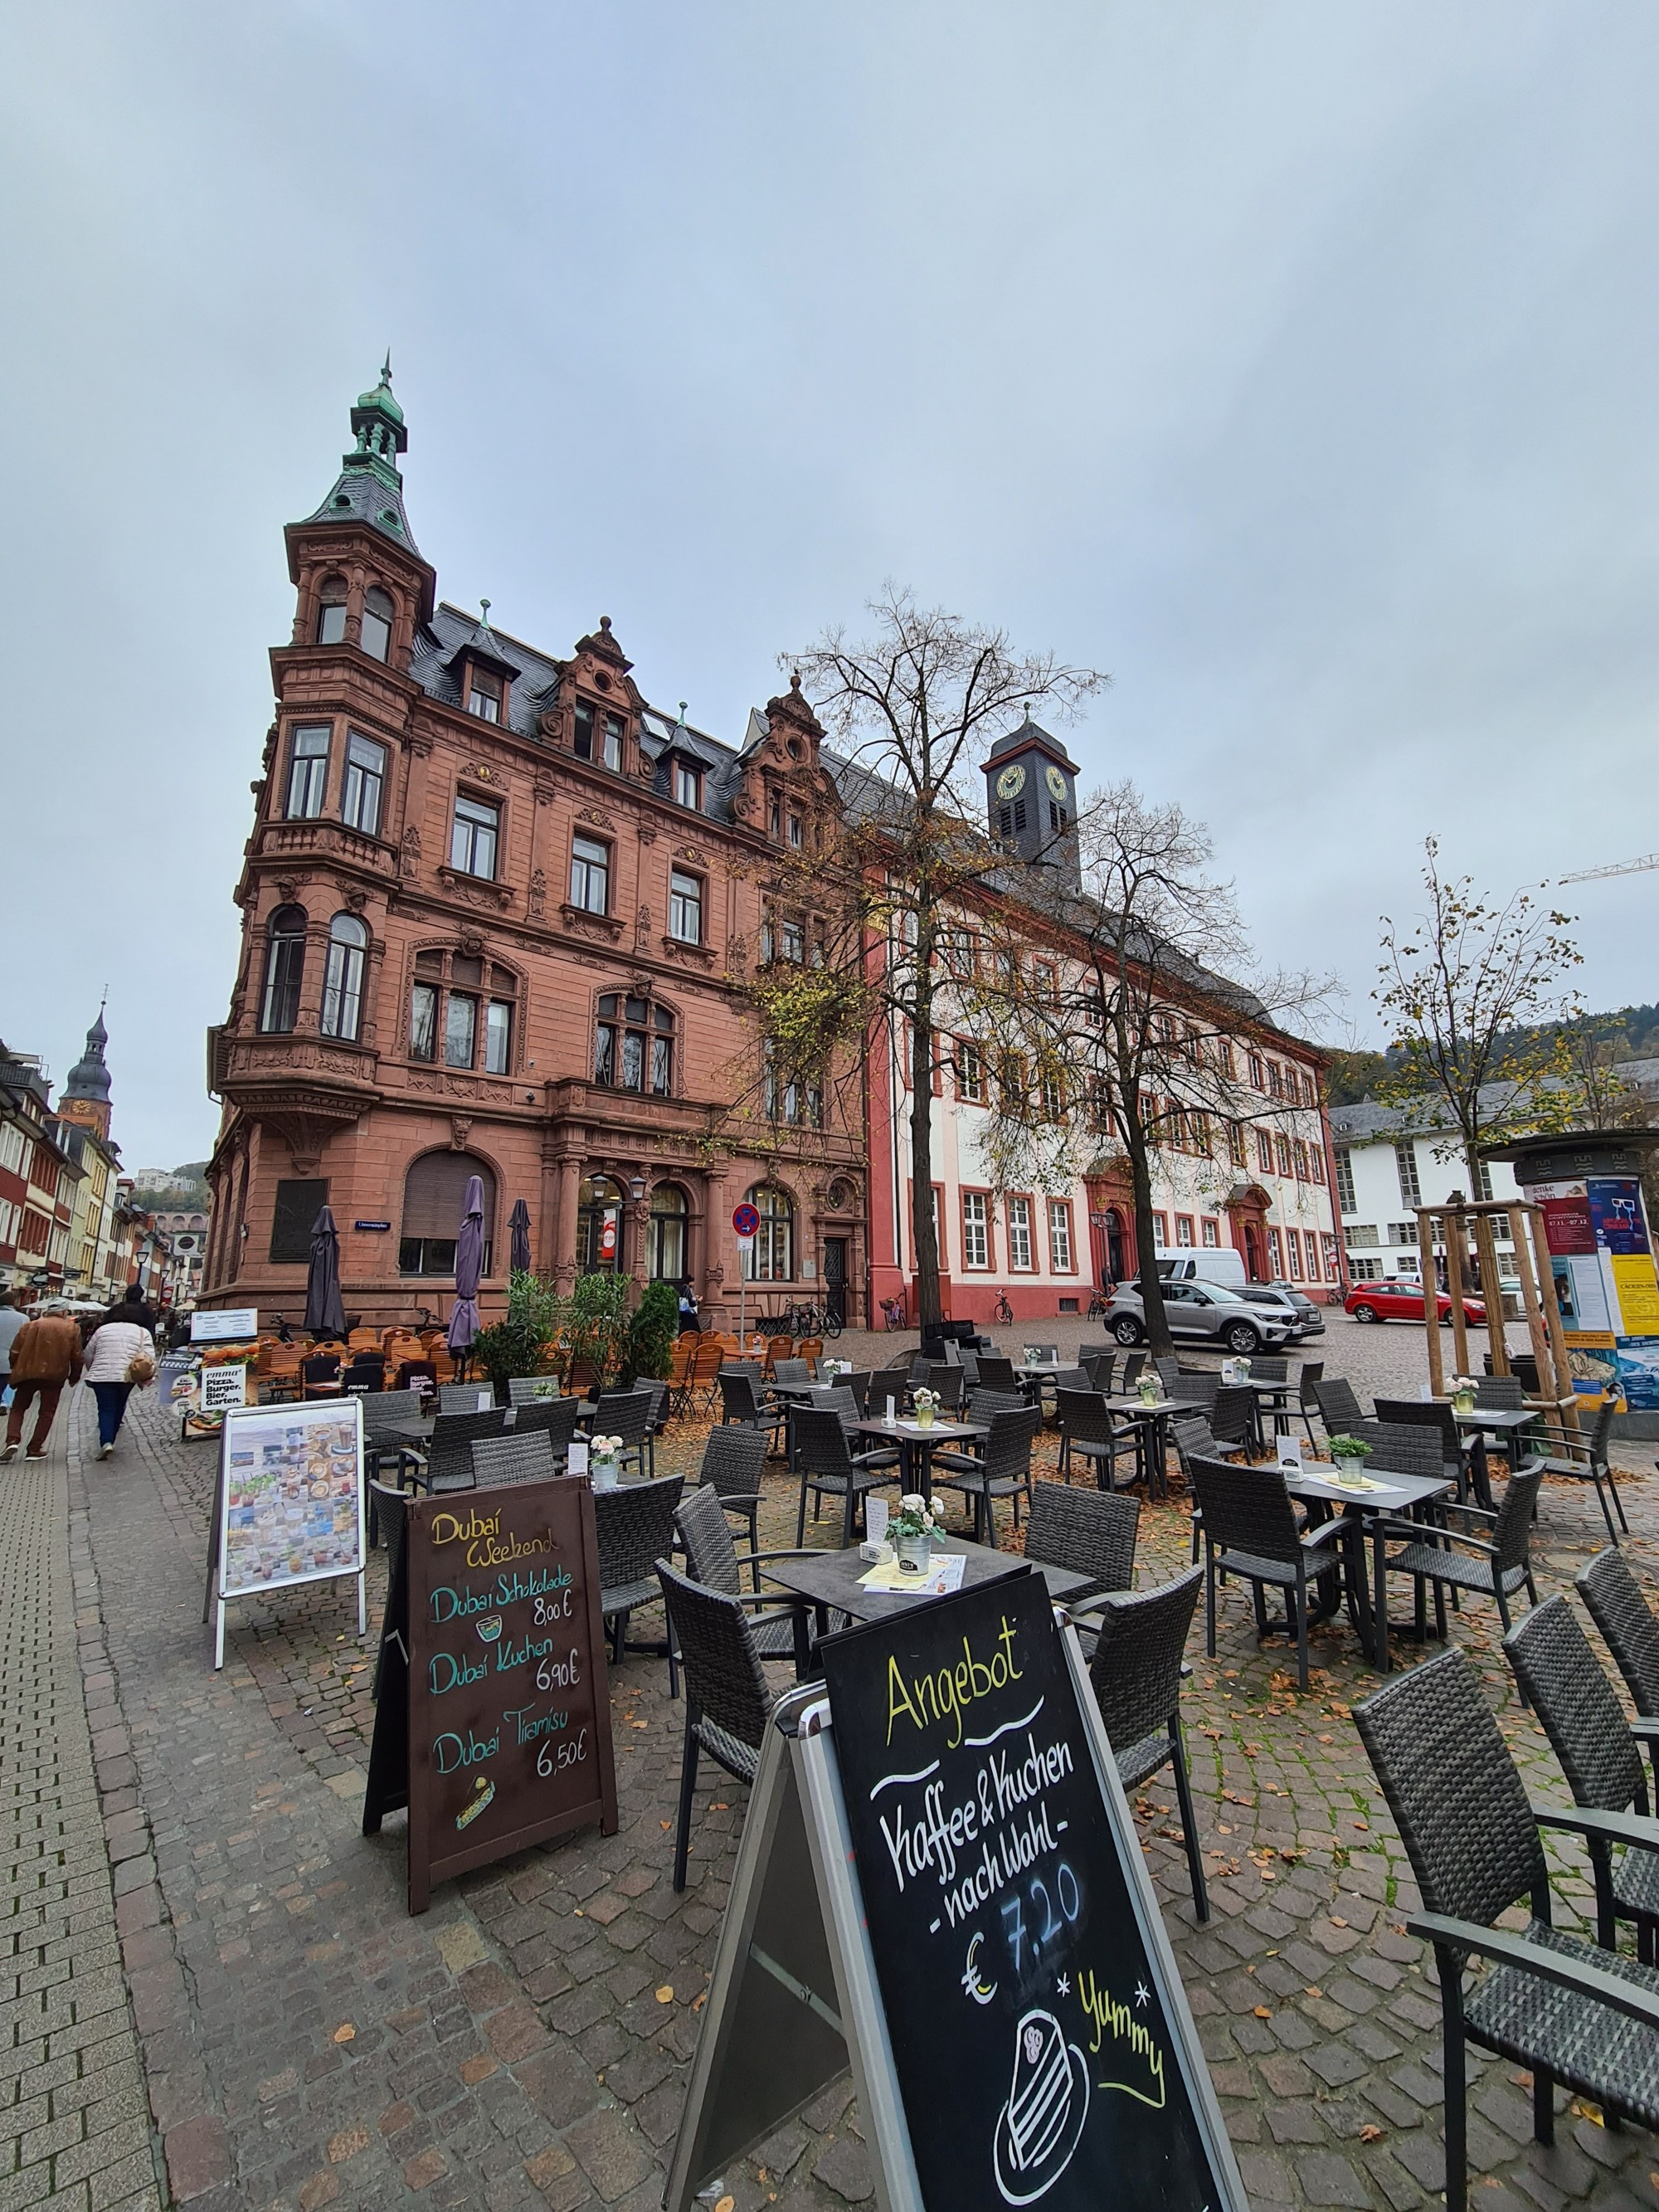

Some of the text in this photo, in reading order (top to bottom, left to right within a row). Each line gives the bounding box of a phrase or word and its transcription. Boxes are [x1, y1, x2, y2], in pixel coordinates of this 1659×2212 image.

[206, 1385, 241, 1393] Burger.
[206, 1397, 241, 1406] Garten.
[431, 1508, 501, 1545] Dubai
[466, 1528, 561, 1567] Weekend
[430, 1564, 574, 1624] Dubai Schokolade
[429, 1635, 553, 1694] Dubai Kuchen
[887, 1615, 1024, 1750] Angebot
[432, 1702, 568, 1774] Dubai Tiramisu
[879, 1732, 1074, 1893] Kaffee & Kuchen
[1078, 1968, 1165, 2108] Yummy
